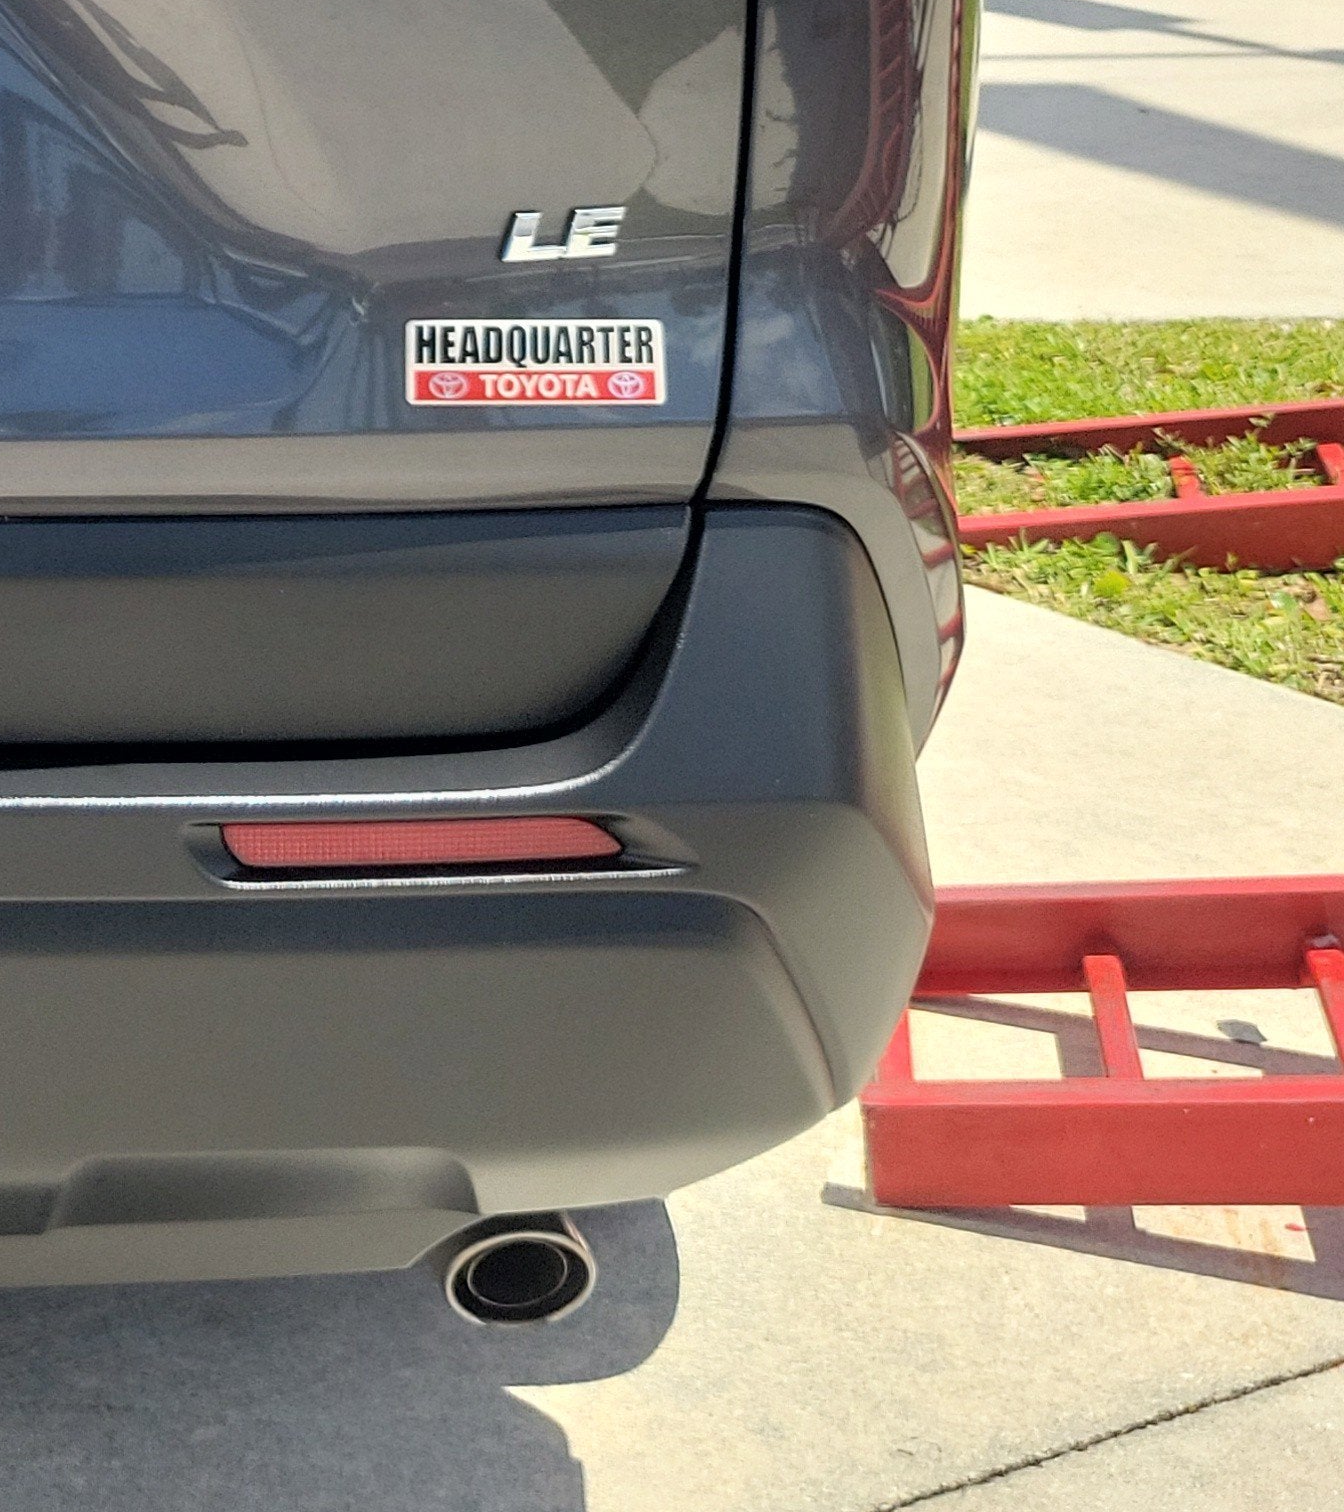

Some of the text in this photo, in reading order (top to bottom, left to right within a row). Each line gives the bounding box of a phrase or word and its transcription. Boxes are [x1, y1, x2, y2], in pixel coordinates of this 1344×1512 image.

[498, 205, 627, 263] LE
[414, 325, 654, 368] HEADQUARTER
[478, 373, 599, 398] TOYOTA
